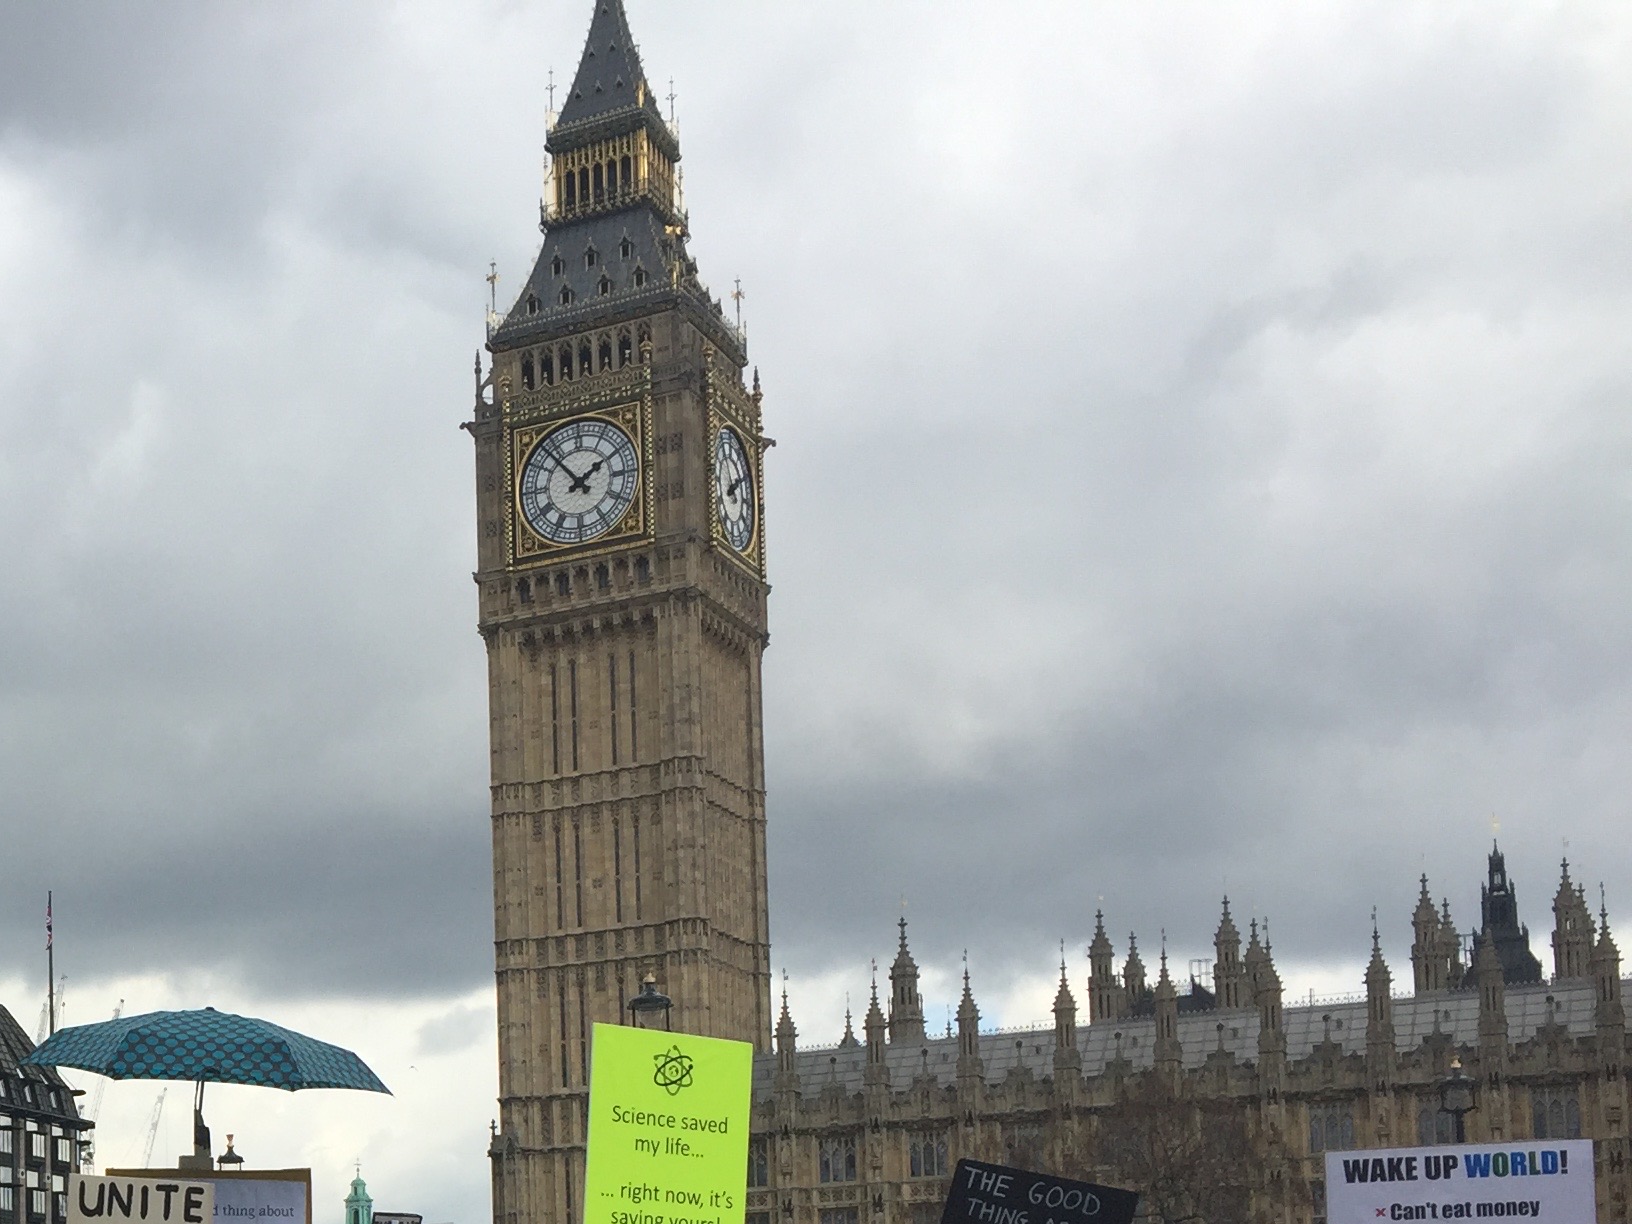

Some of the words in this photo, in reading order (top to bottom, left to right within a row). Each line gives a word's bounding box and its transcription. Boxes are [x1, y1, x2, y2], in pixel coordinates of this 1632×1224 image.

[611, 1105, 677, 1128] Science
[680, 1116, 729, 1135] saved
[634, 1140, 660, 1158] my
[1342, 1156, 1419, 1184] WAKE
[1424, 1154, 1459, 1181] UP
[1464, 1150, 1569, 1179] WORLD!
[78, 1179, 205, 1224] UNITE
[620, 1182, 660, 1205] right
[665, 1190, 704, 1209] now,
[709, 1188, 734, 1209] it's
[964, 1165, 1015, 1198] THE
[1028, 1181, 1102, 1216] GOOD
[223, 1204, 256, 1220] thing
[259, 1204, 295, 1217] about
[1390, 1202, 1438, 1221] Can't
[1441, 1202, 1473, 1220] eat
[1476, 1199, 1541, 1219] money
